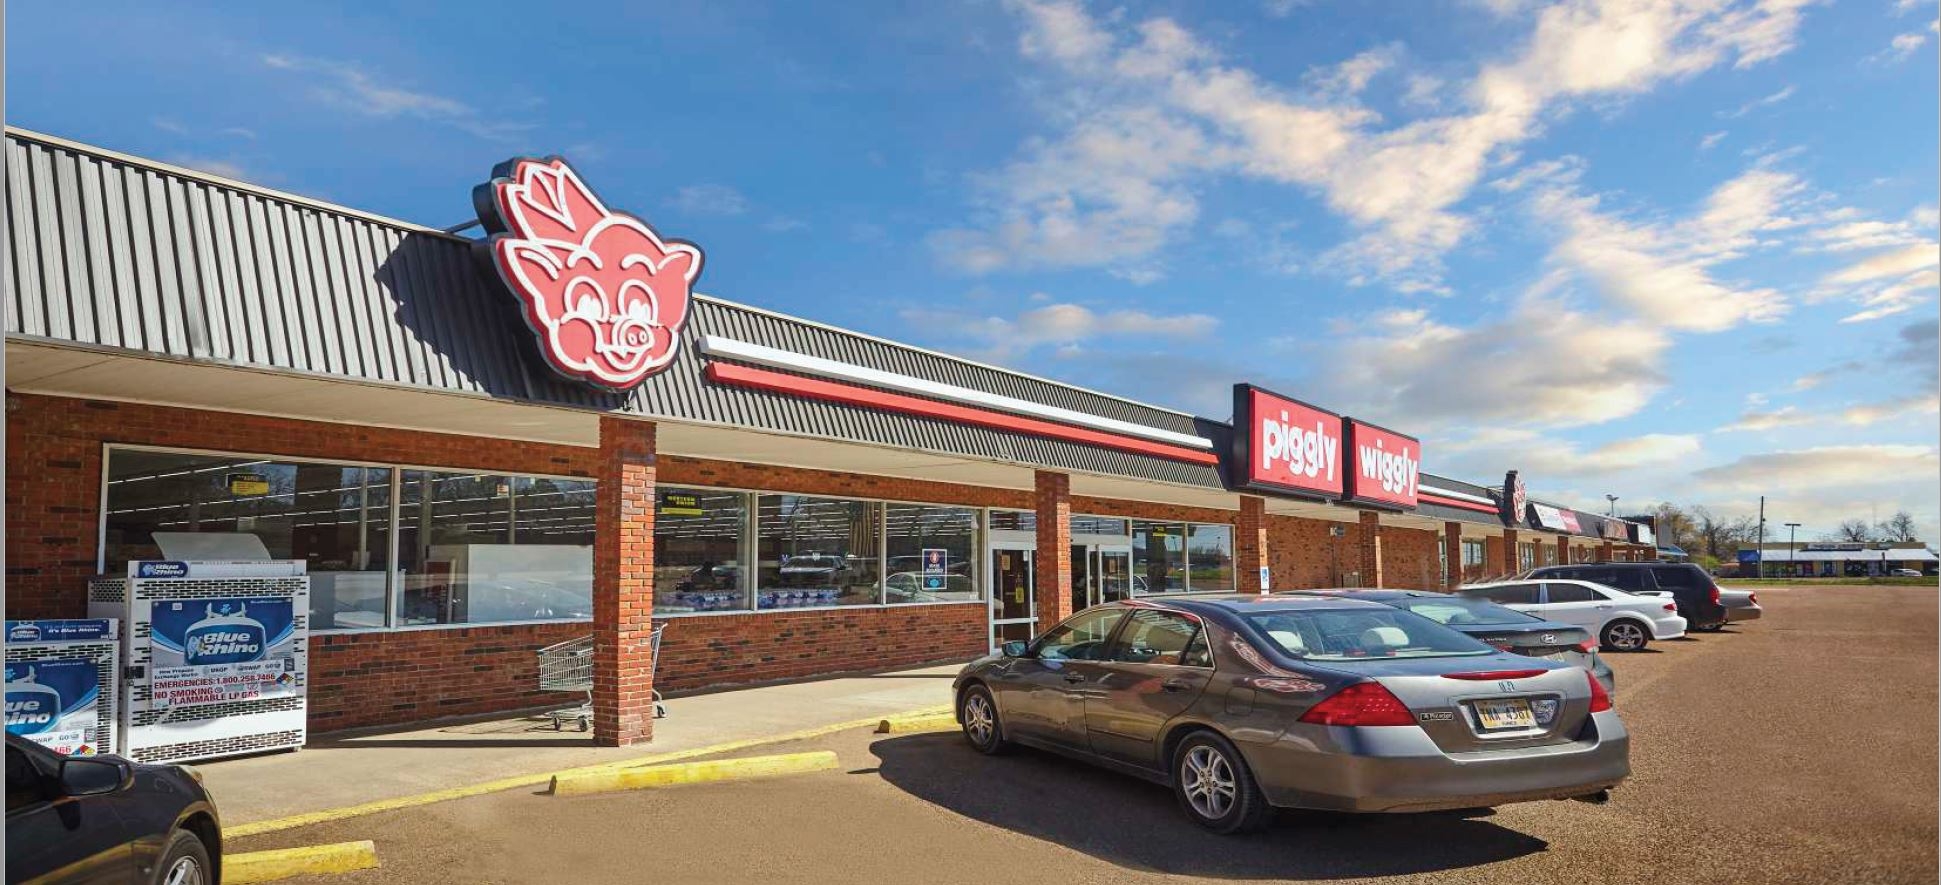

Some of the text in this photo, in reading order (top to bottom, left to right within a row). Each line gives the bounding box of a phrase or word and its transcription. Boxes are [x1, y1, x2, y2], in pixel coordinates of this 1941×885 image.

[1262, 410, 1337, 481] piggly
[1359, 438, 1418, 497] wiggly
[203, 631, 250, 643] Blue
[199, 643, 259, 656] Rhino
[154, 690, 168, 700] NO
[169, 687, 214, 698] SMOKING
[168, 694, 226, 707] FLAMMABLE
[228, 692, 240, 700] LP
[241, 690, 260, 699] GAS
